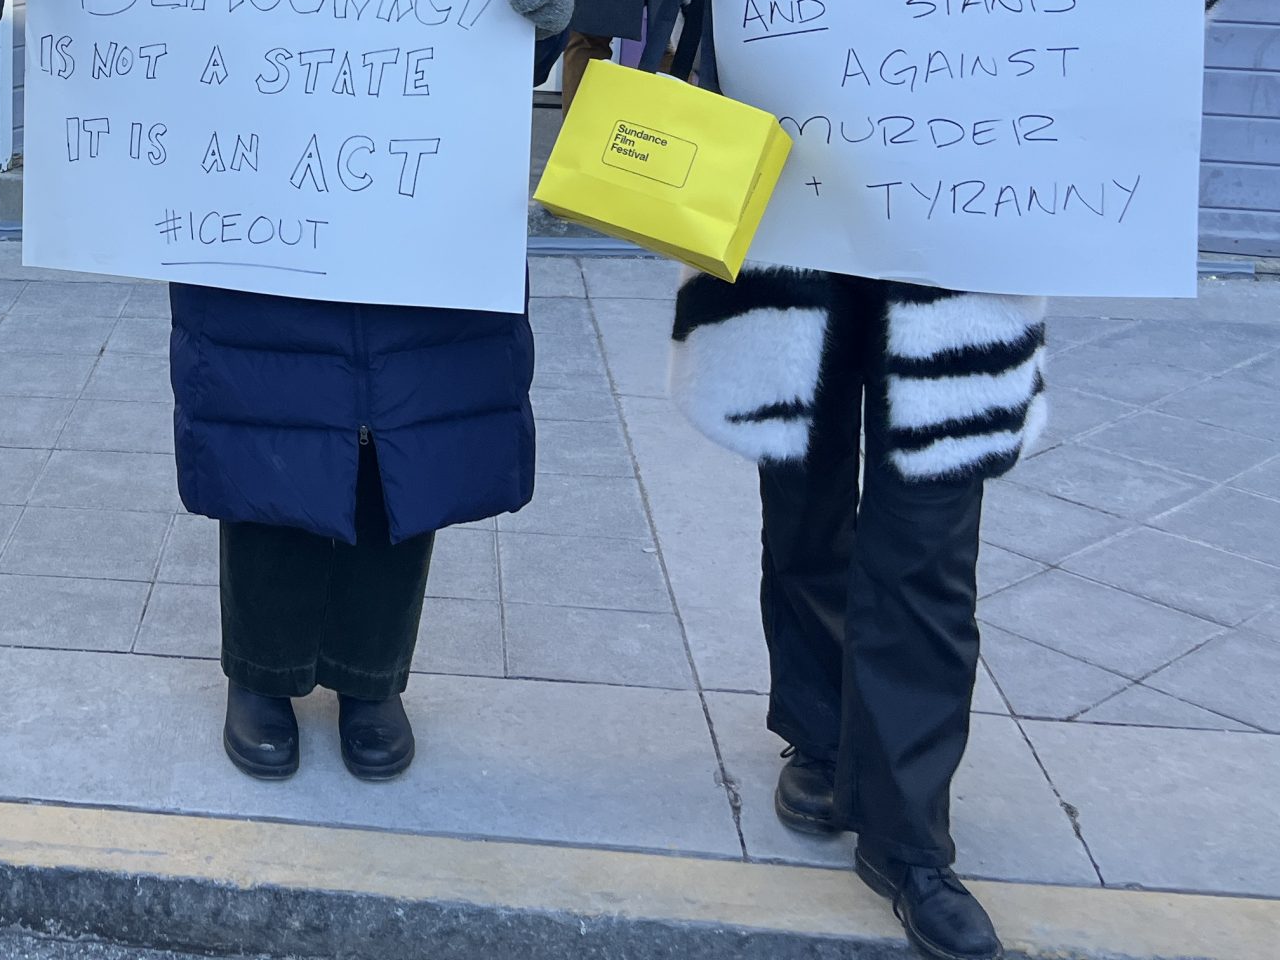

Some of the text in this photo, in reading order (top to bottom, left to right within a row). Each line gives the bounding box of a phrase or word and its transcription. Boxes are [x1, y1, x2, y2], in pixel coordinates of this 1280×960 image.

[40, 35, 434, 96] IS NOT A STATE
[841, 46, 1079, 92] AGAINST
[613, 134, 635, 147] Film
[618, 124, 668, 147] Sundance
[778, 114, 1058, 148] MURDER
[66, 117, 440, 197] IT IS AN ACT
[610, 143, 649, 162] Festival
[805, 174, 1141, 224] + TYRANNY
[155, 208, 329, 249] #ICEOUT
